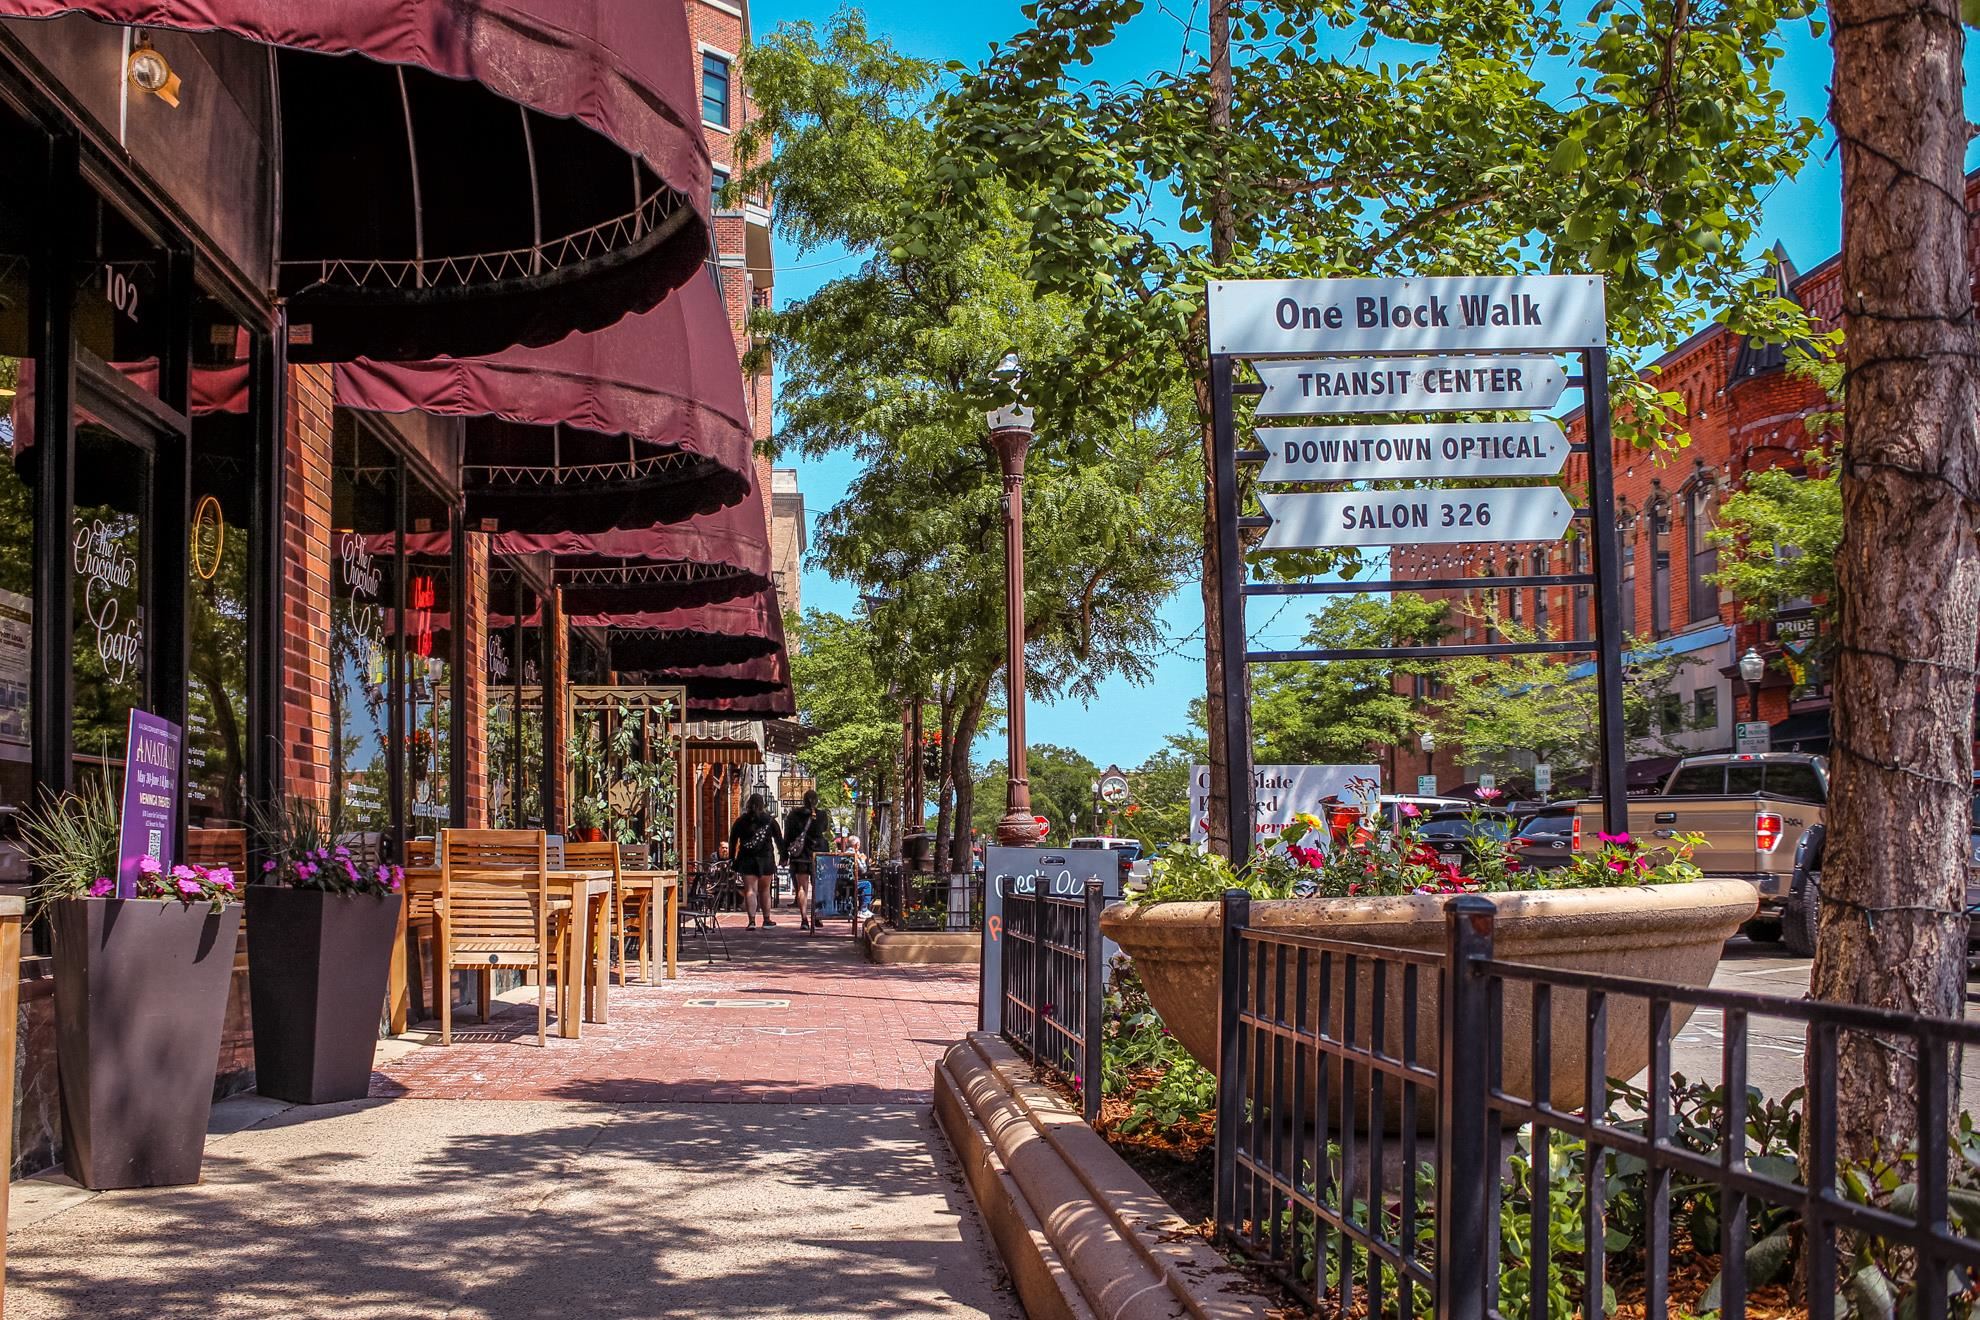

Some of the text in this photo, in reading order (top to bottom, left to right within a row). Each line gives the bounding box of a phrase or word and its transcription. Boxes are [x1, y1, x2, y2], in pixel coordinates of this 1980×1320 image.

[105, 264, 138, 323] 102
[1275, 293, 1542, 330] One Block Walk
[1298, 368, 1523, 397] TRANSIT CENTER
[1284, 436, 1547, 464] DOWNTOWN OPTICAL
[1342, 502, 1491, 530] SALON 326
[73, 518, 136, 588] Chocolate
[94, 519, 113, 558] The
[341, 533, 382, 596] Chocolate
[1776, 619, 1815, 634] PRIDE
[1738, 727, 1745, 736] 2
[1199, 772, 1293, 789] Clate
